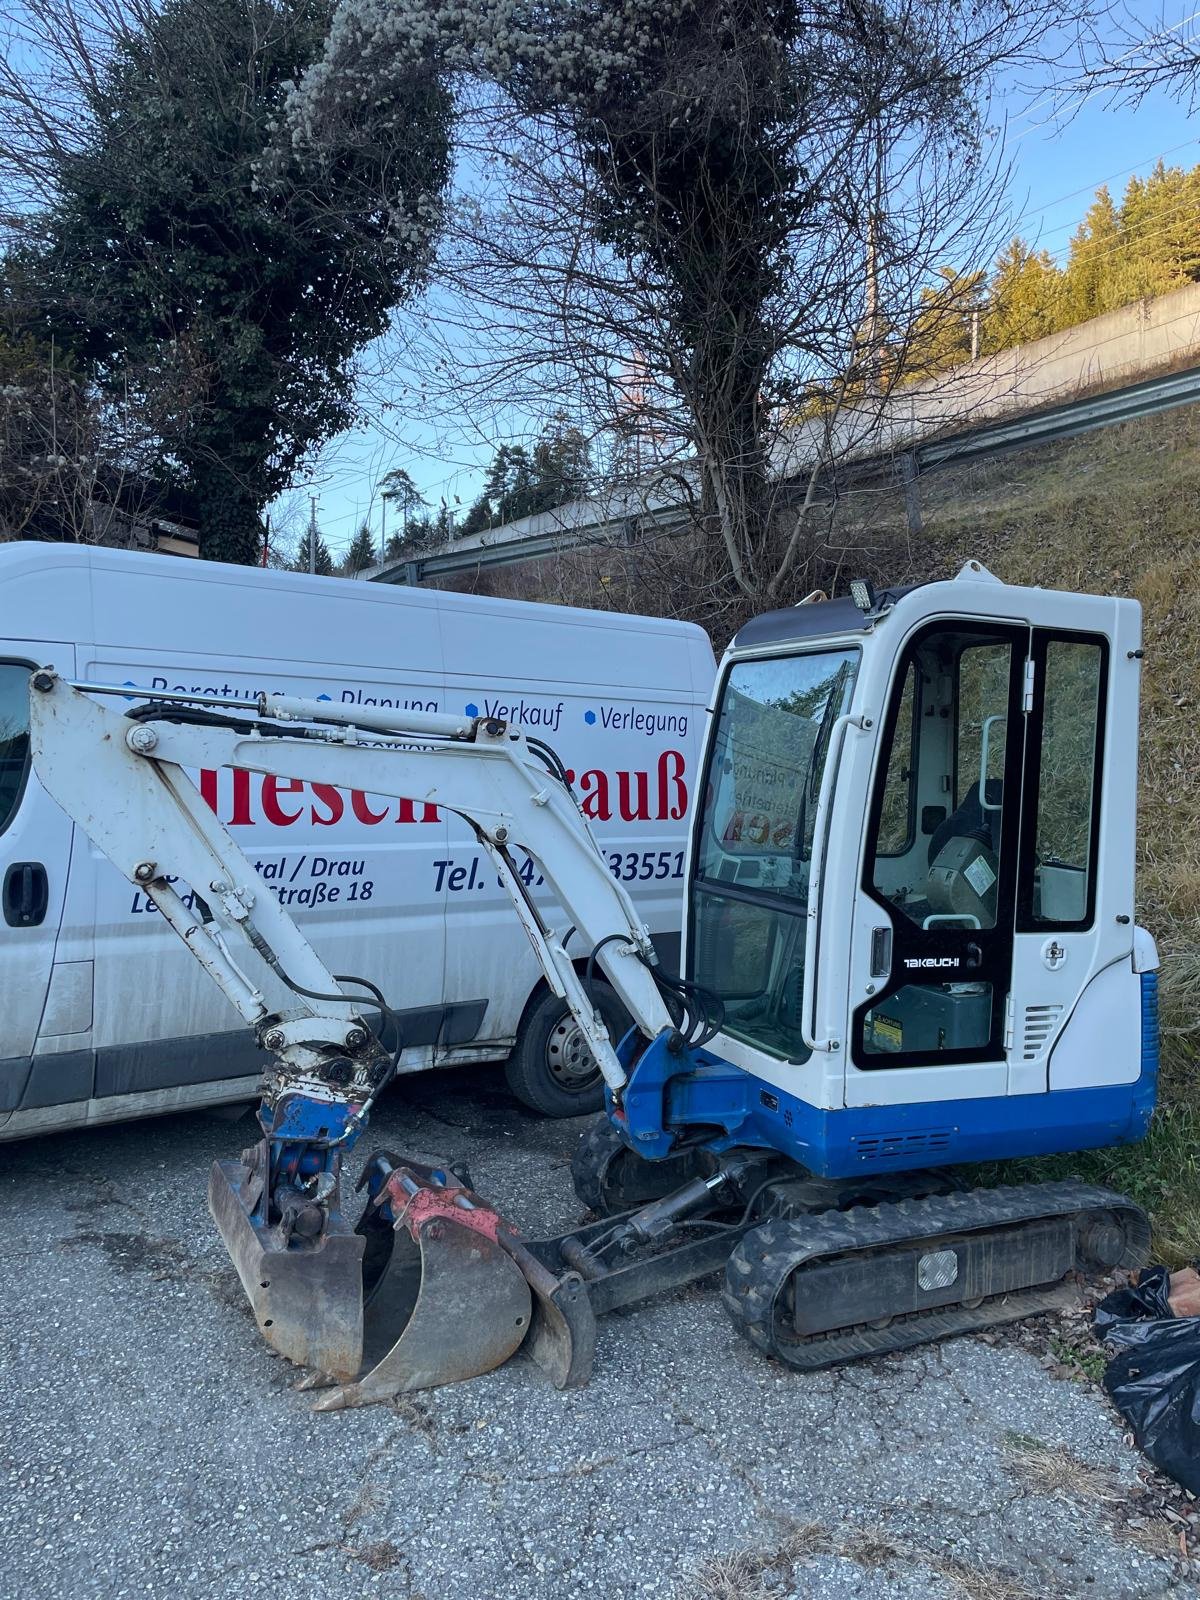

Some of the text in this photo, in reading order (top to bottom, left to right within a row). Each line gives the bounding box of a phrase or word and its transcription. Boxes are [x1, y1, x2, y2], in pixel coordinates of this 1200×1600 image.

[484, 699, 564, 731] Verkauf
[601, 706, 688, 737] Verlegung
[310, 857, 365, 877] Drau
[433, 858, 484, 892] Tel.
[346, 881, 374, 901] 18
